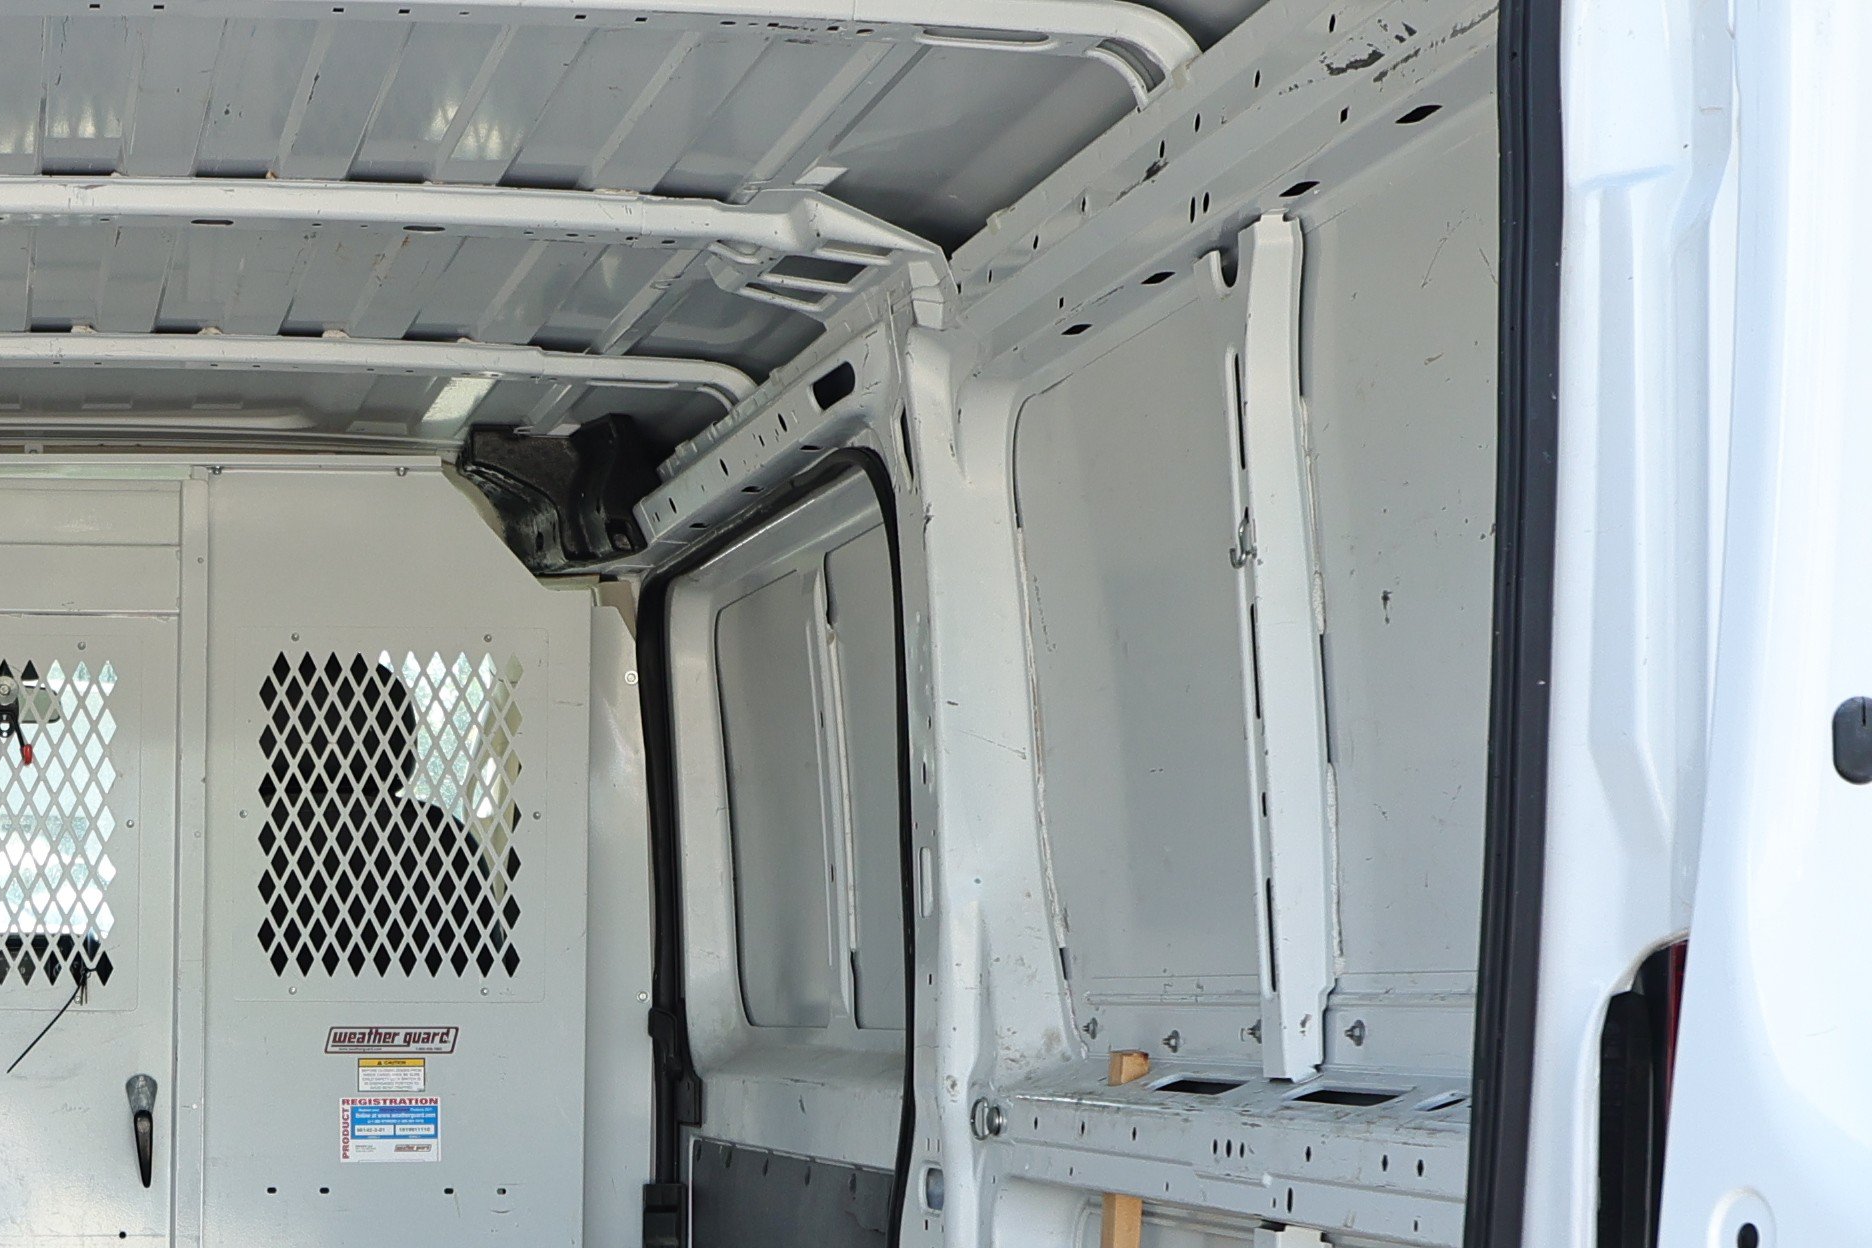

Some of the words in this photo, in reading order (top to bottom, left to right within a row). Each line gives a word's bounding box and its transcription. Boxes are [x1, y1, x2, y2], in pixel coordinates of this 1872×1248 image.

[331, 1027, 400, 1044] weather
[403, 1027, 450, 1047] guard
[341, 1107, 350, 1159] PRODUCT
